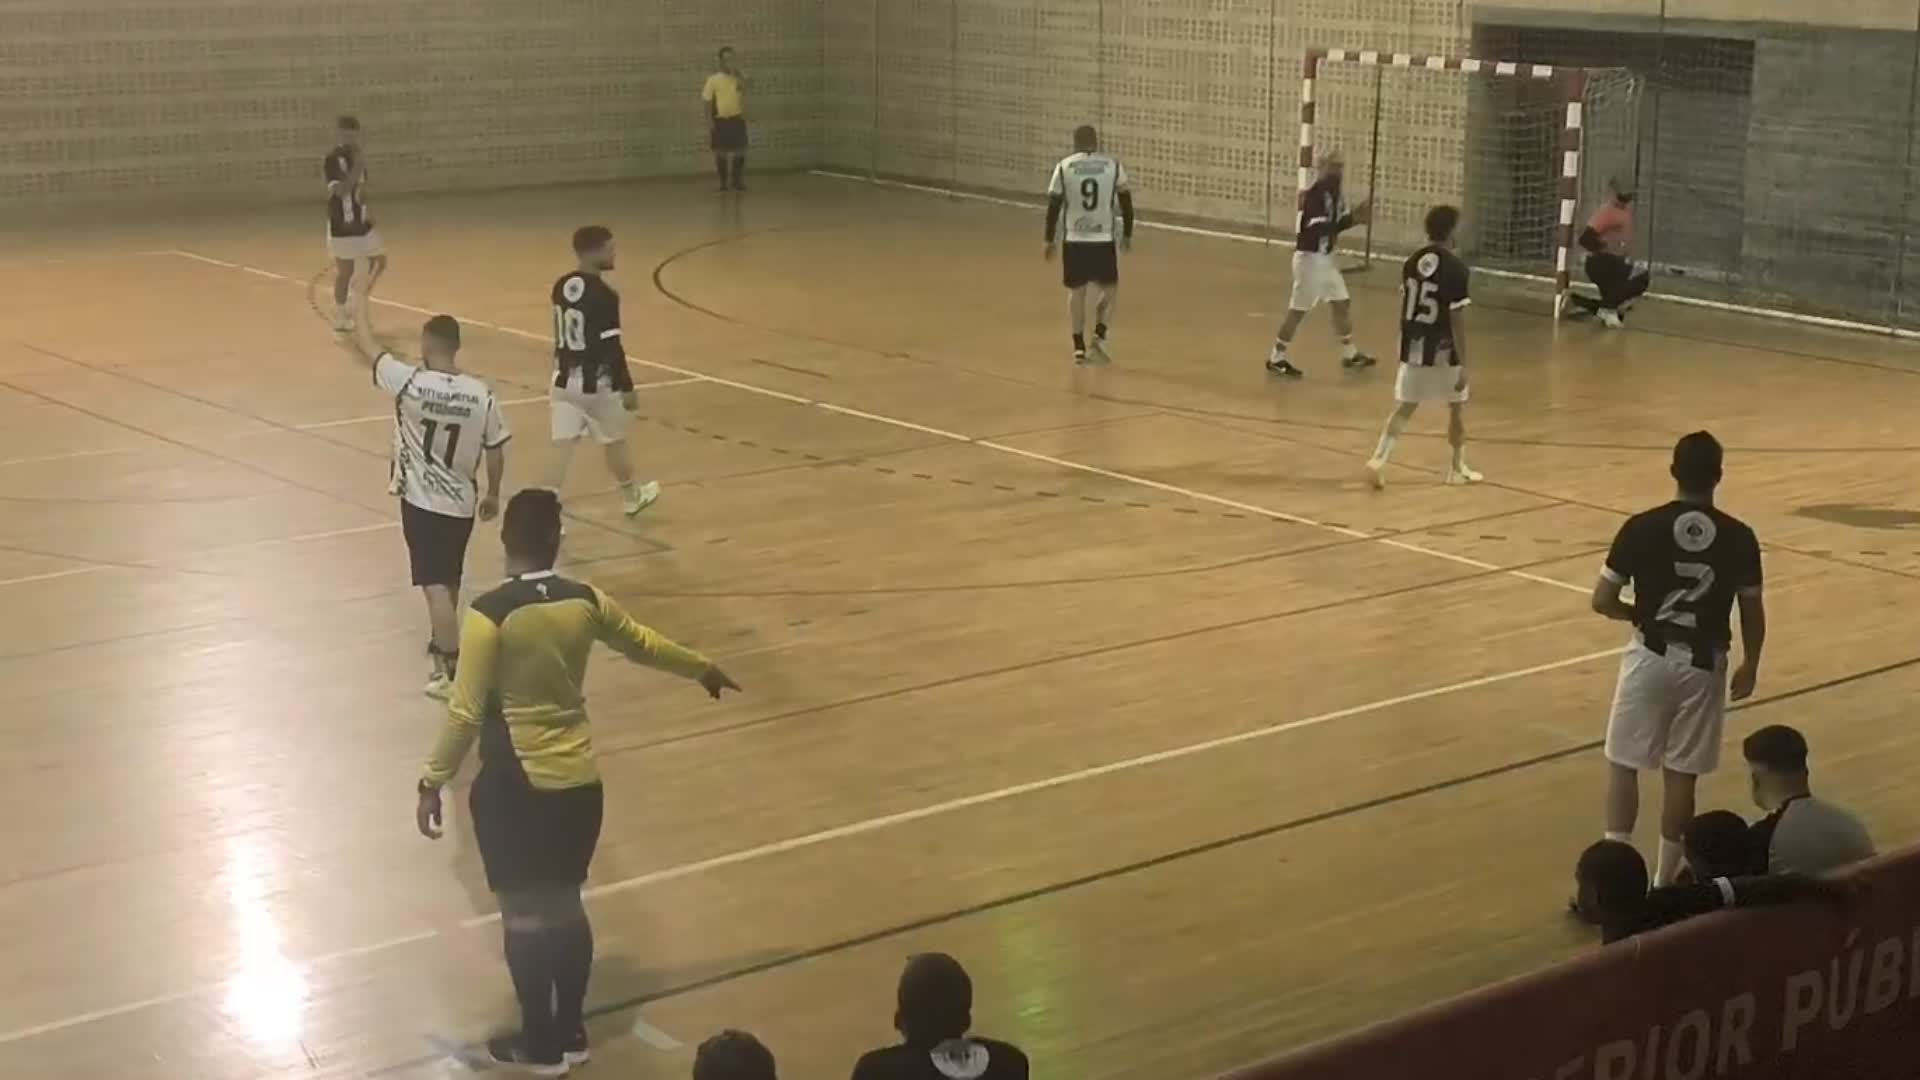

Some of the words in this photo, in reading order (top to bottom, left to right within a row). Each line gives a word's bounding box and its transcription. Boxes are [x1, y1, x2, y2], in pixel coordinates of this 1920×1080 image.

[1081, 177, 1098, 212] 9
[1406, 277, 1439, 325] 15
[555, 304, 586, 351] 10
[420, 418, 462, 469] 11
[1656, 561, 1716, 628] 2
